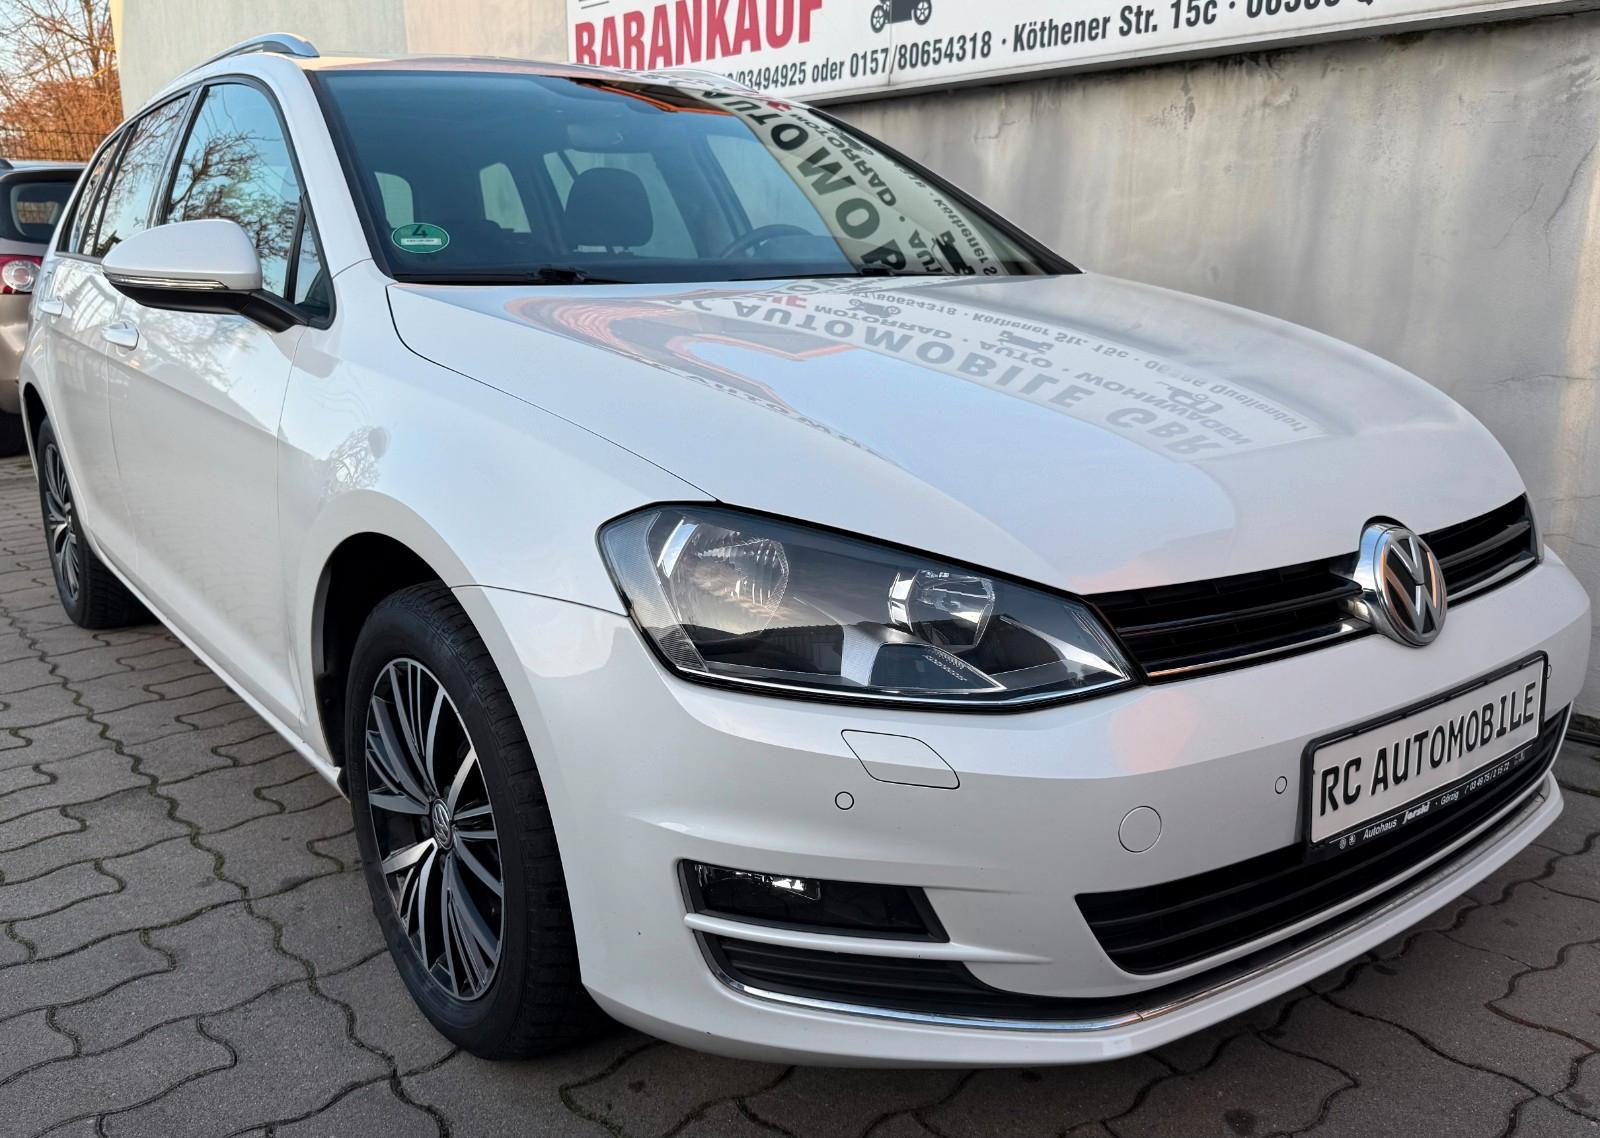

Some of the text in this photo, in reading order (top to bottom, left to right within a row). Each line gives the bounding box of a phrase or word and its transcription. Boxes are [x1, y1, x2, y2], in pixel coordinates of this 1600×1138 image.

[811, 57, 845, 82] oder
[849, 30, 992, 77] 0157/80654318
[1013, 15, 1110, 52] Köthener
[1119, 4, 1158, 37] Str.
[1170, 0, 1218, 29] 15c
[1320, 682, 1536, 816] RC AUTOMOBILE
[1363, 818, 1398, 840] Autohaus
